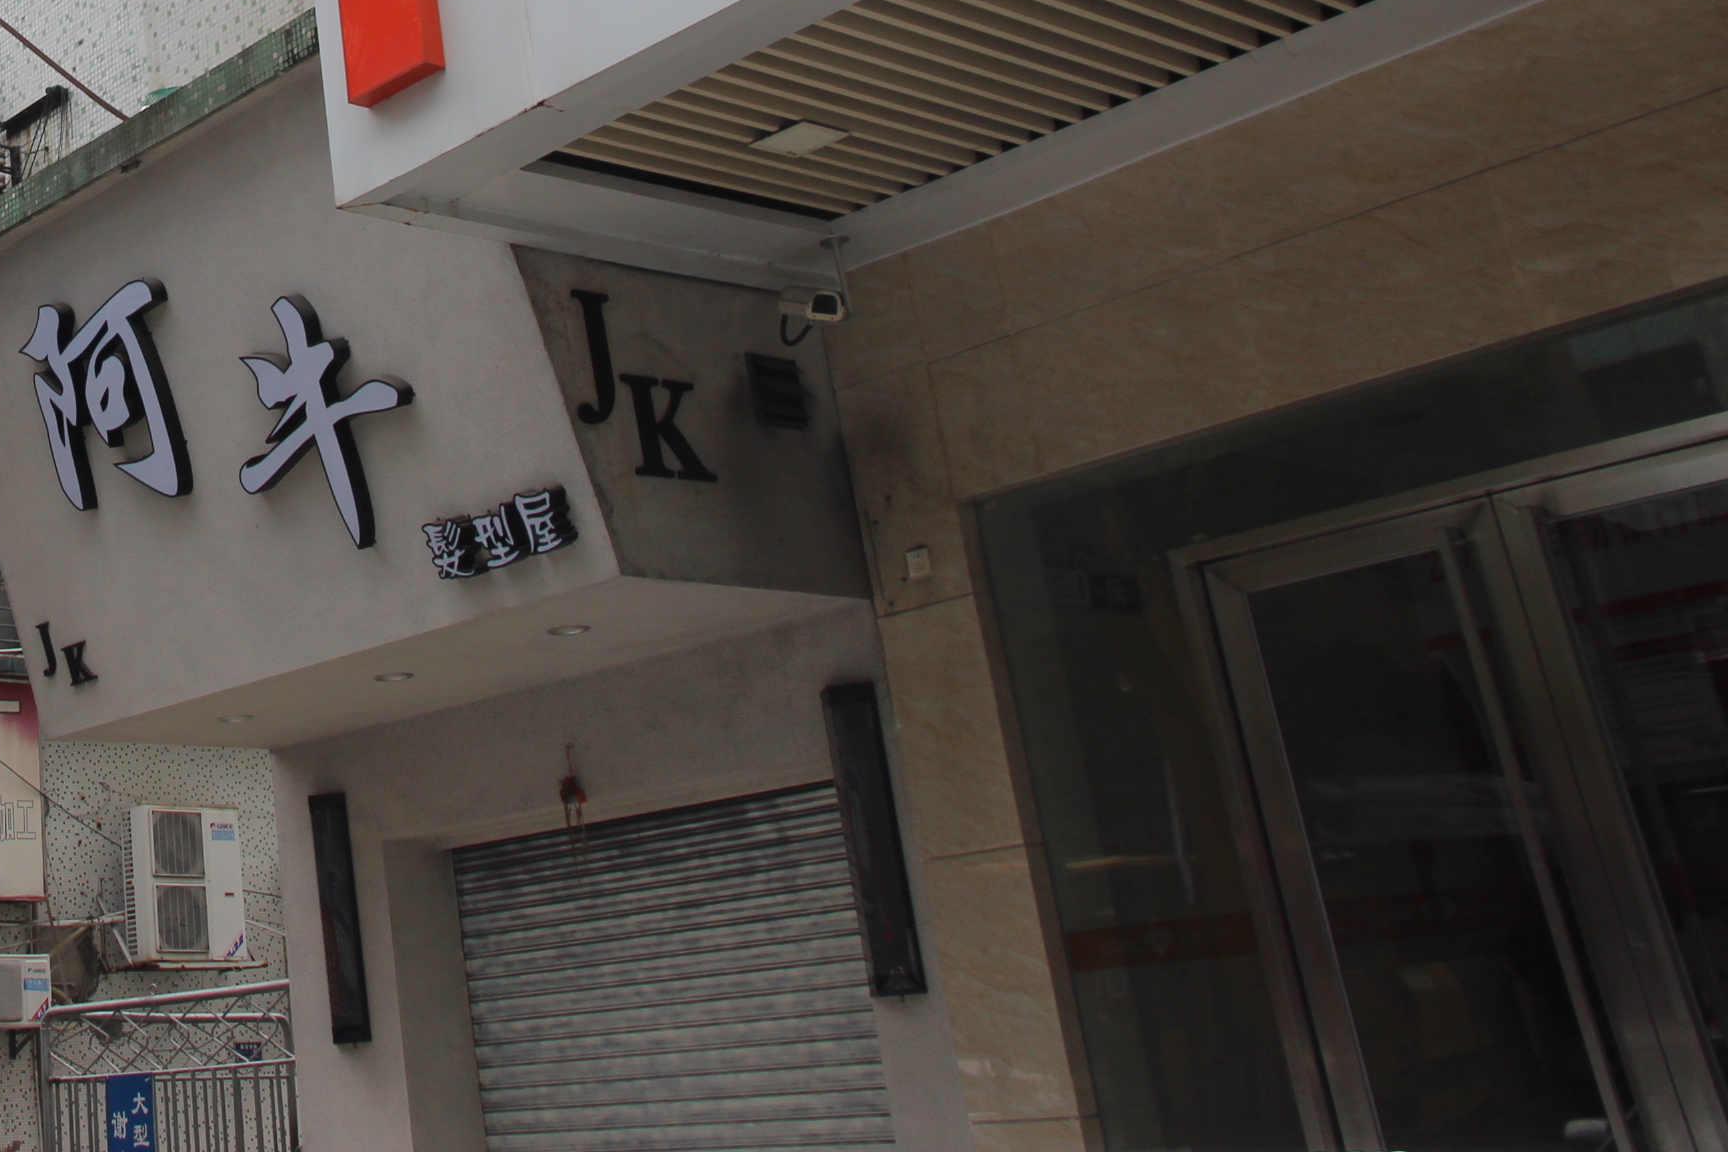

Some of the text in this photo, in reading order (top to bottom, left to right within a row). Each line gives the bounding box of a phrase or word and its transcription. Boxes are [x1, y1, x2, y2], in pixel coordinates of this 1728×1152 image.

[570, 288, 718, 483] JK
[36, 620, 99, 686] JK
[131, 1091, 150, 1148] 大型
